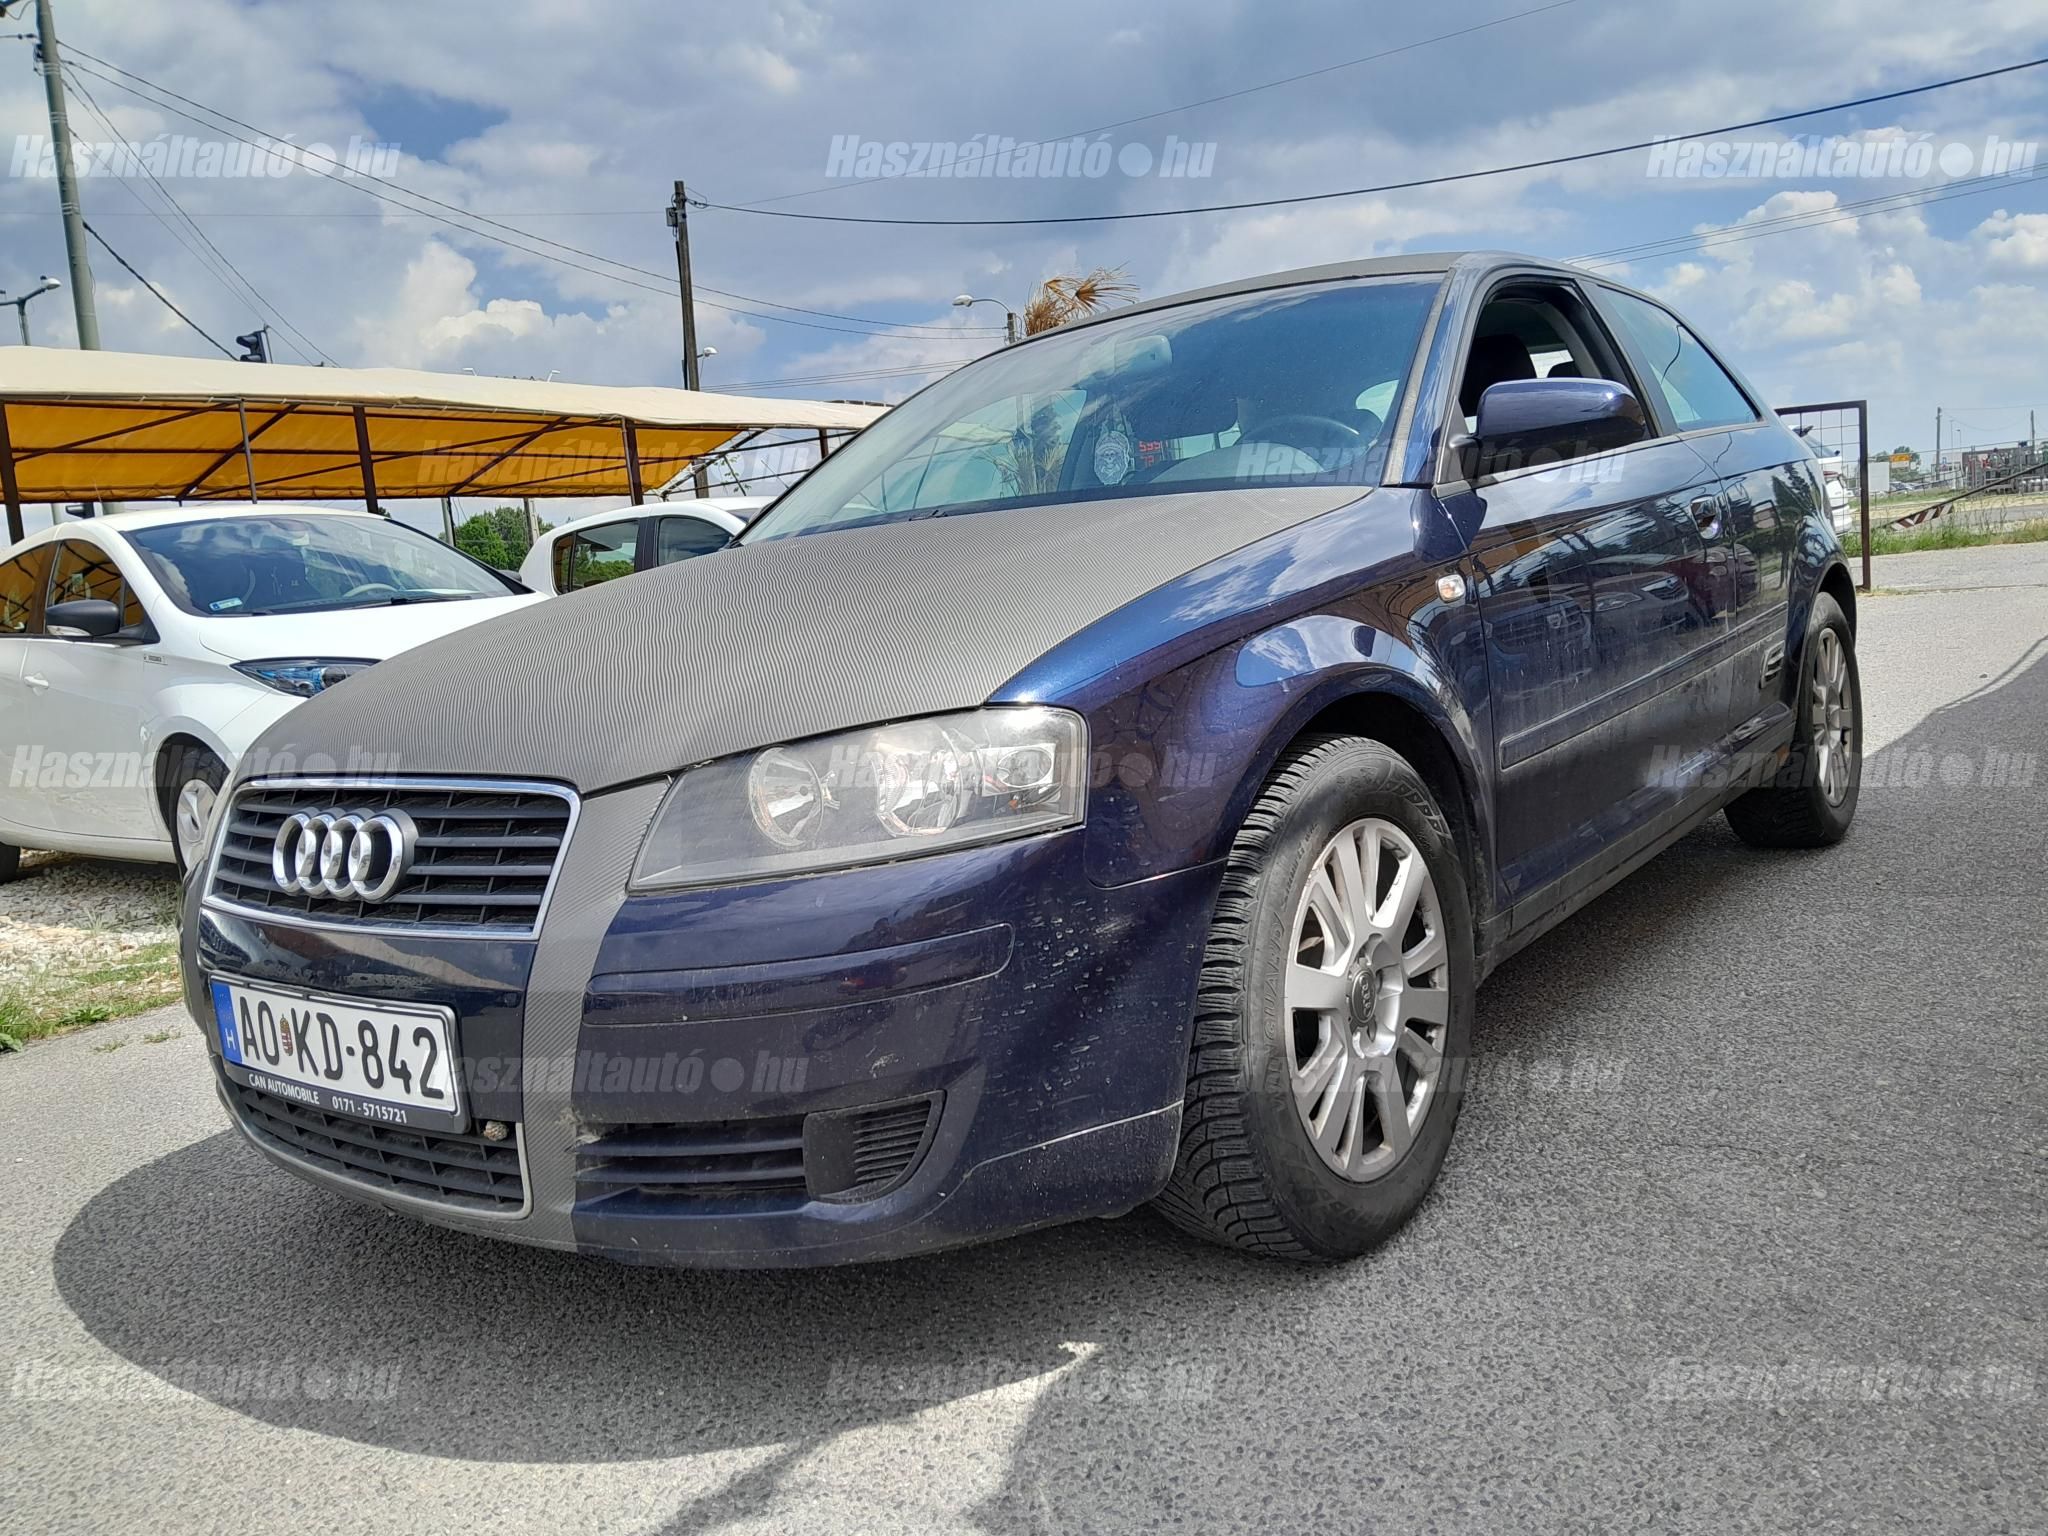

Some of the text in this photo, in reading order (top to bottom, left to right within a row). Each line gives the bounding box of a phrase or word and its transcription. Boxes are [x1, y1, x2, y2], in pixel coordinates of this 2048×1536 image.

[225, 1028, 237, 1051] H
[239, 996, 280, 1067] AO
[248, 1073, 267, 1090] CAN
[267, 1079, 320, 1105] AUTOMOBILE
[362, 1102, 407, 1124] 5715721
